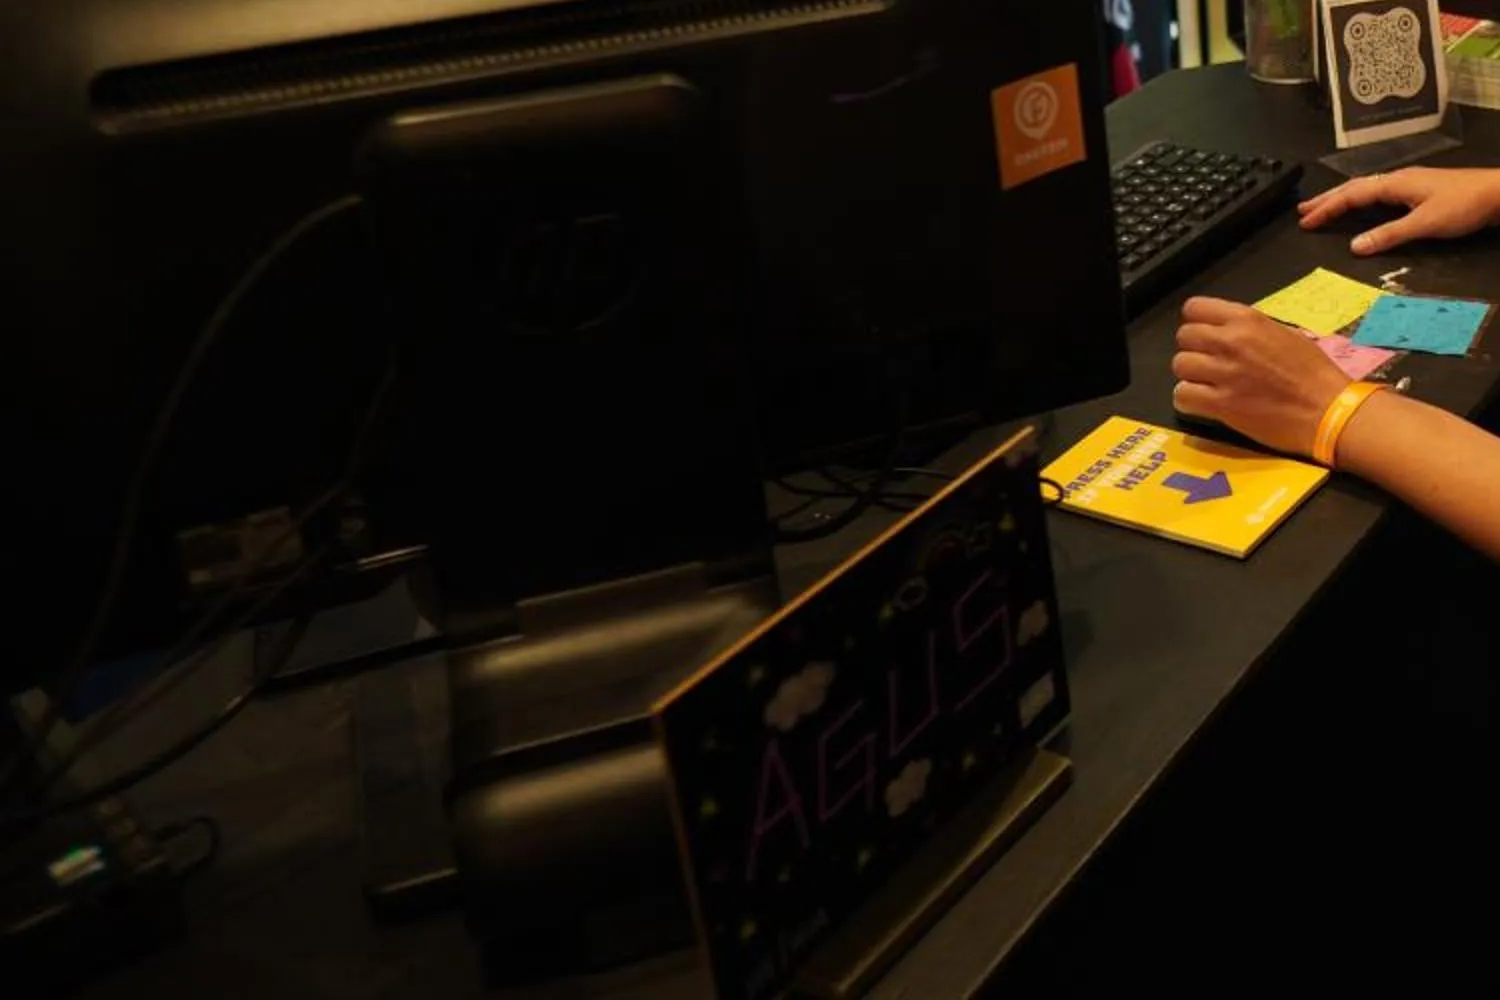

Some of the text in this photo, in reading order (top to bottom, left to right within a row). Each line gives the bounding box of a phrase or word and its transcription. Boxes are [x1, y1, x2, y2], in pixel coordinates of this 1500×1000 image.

[1106, 426, 1153, 459] HERE
[1114, 450, 1168, 491] HELP
[745, 567, 1012, 884] AGUS
